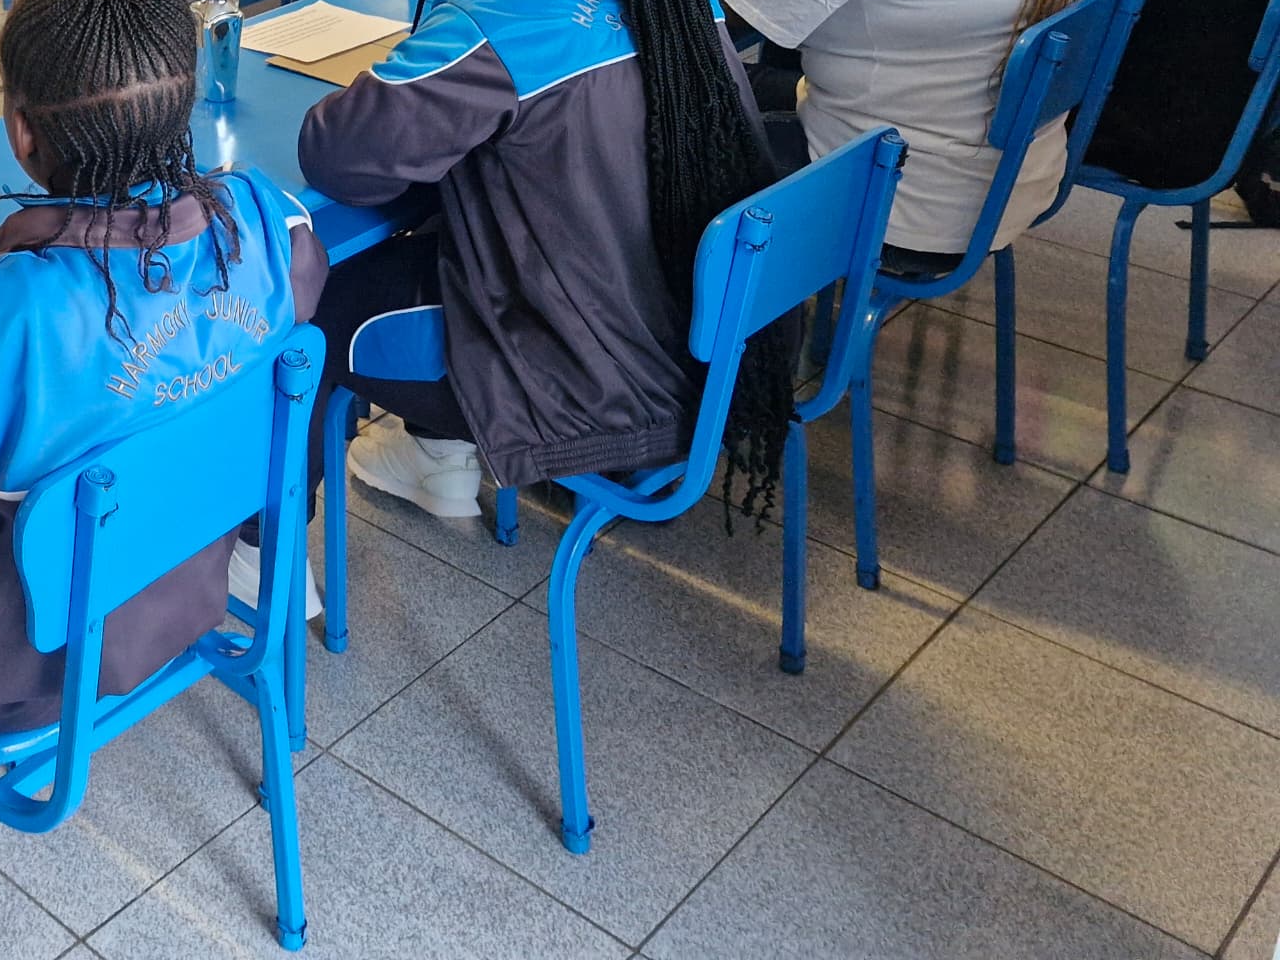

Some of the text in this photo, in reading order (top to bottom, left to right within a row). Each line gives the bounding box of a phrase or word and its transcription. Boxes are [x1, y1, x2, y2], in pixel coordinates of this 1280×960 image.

[106, 291, 271, 399] HARMONY JUNIOR
[153, 351, 244, 407] SCHOOL
